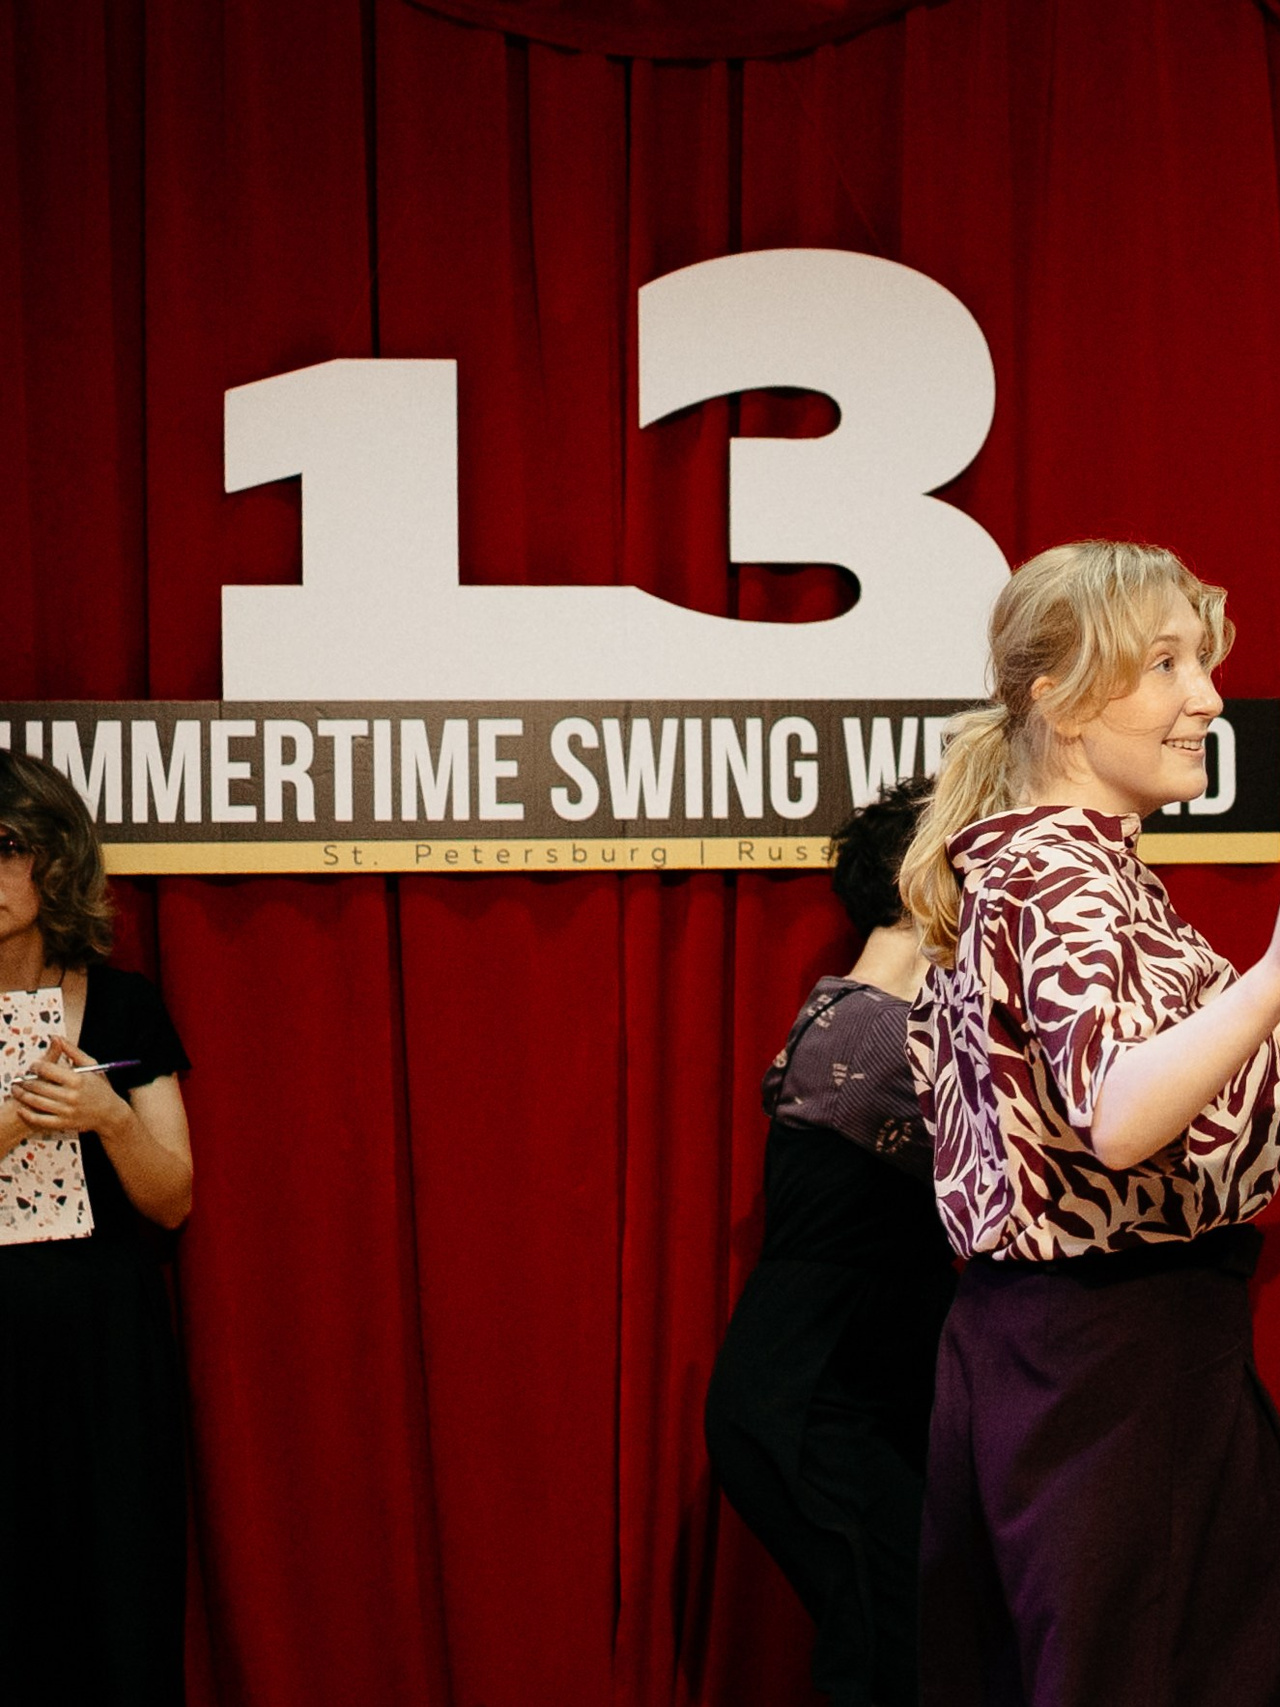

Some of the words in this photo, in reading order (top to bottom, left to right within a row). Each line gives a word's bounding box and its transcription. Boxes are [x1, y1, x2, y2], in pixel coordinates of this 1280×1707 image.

[221, 247, 1013, 702] 13
[0, 718, 525, 824] MMERTIME
[550, 716, 819, 821] SWING
[323, 844, 378, 866] St.
[414, 842, 668, 870] Petersburg
[738, 840, 832, 862] Russ
